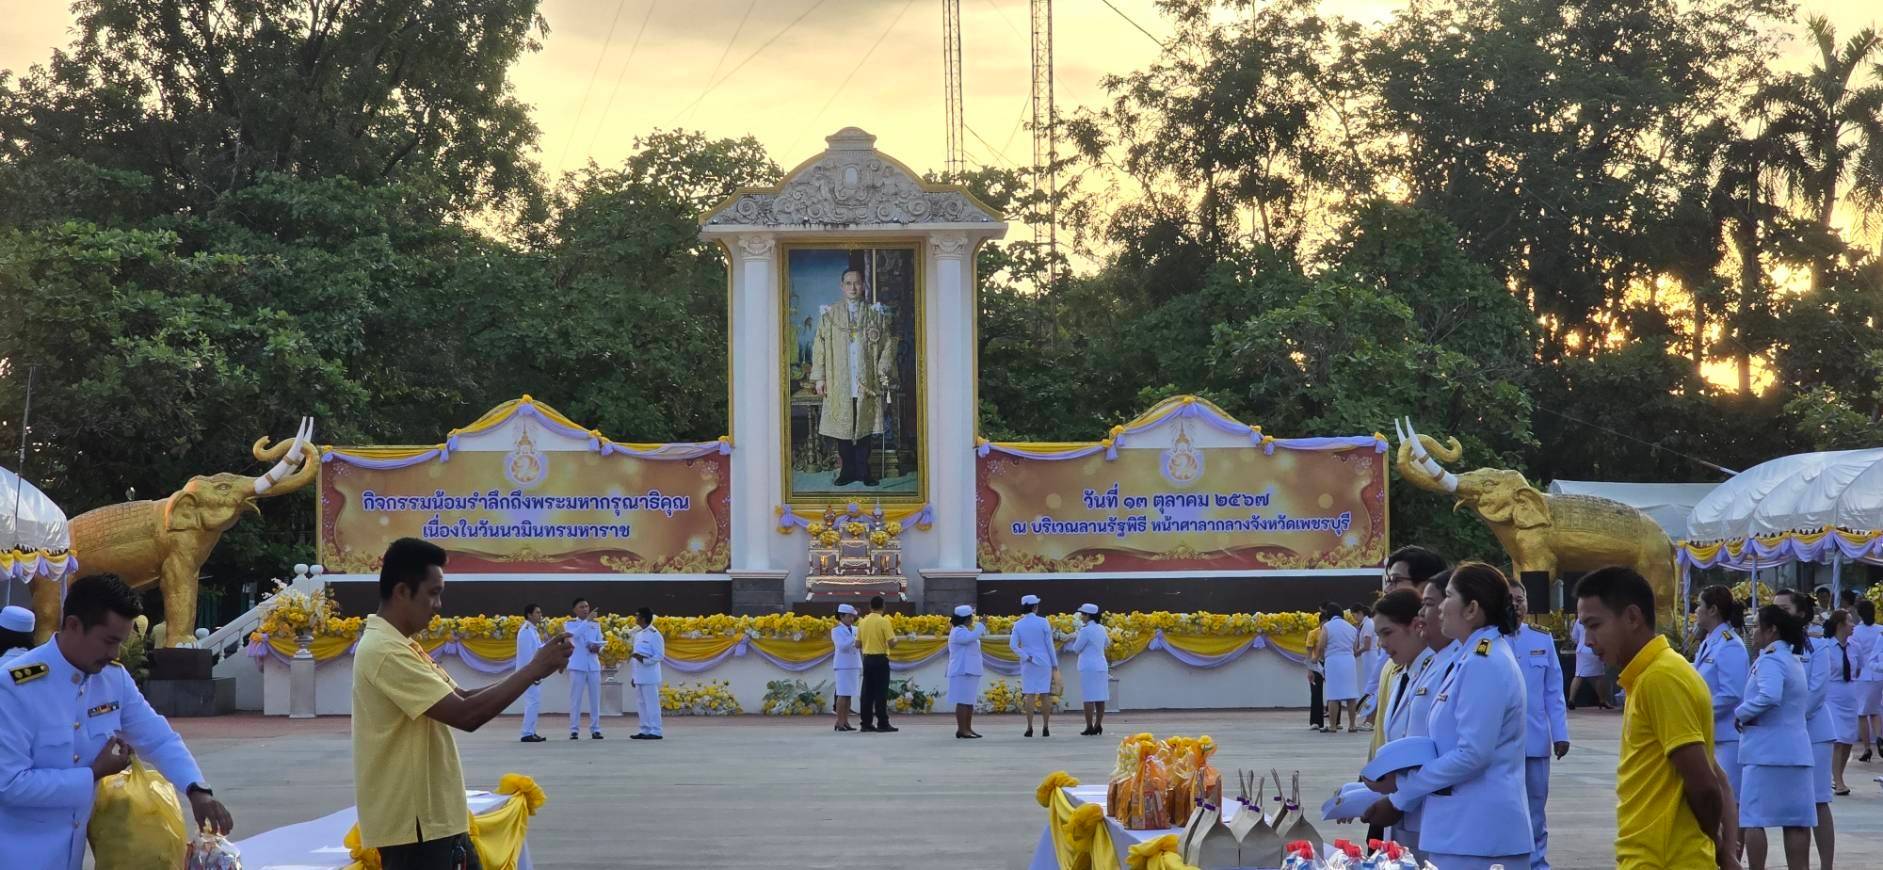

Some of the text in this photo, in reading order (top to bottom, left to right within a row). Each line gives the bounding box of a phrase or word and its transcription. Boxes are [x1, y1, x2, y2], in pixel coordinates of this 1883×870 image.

[363, 490, 690, 517] กิจกรรมน้อมรำลึกถึงพระมหากรุณาธิคุณ
[1082, 483, 1270, 515] วันที่ ๑๓ ตุลาคม ๒๕๖๗
[422, 514, 631, 539] เนื่องในวันนวมินทรมหาราช
[1012, 511, 1351, 539] ณ บริเวณลานรัฐพิธี หน้าศาลากลางจังหวัดเพชรบุรี
